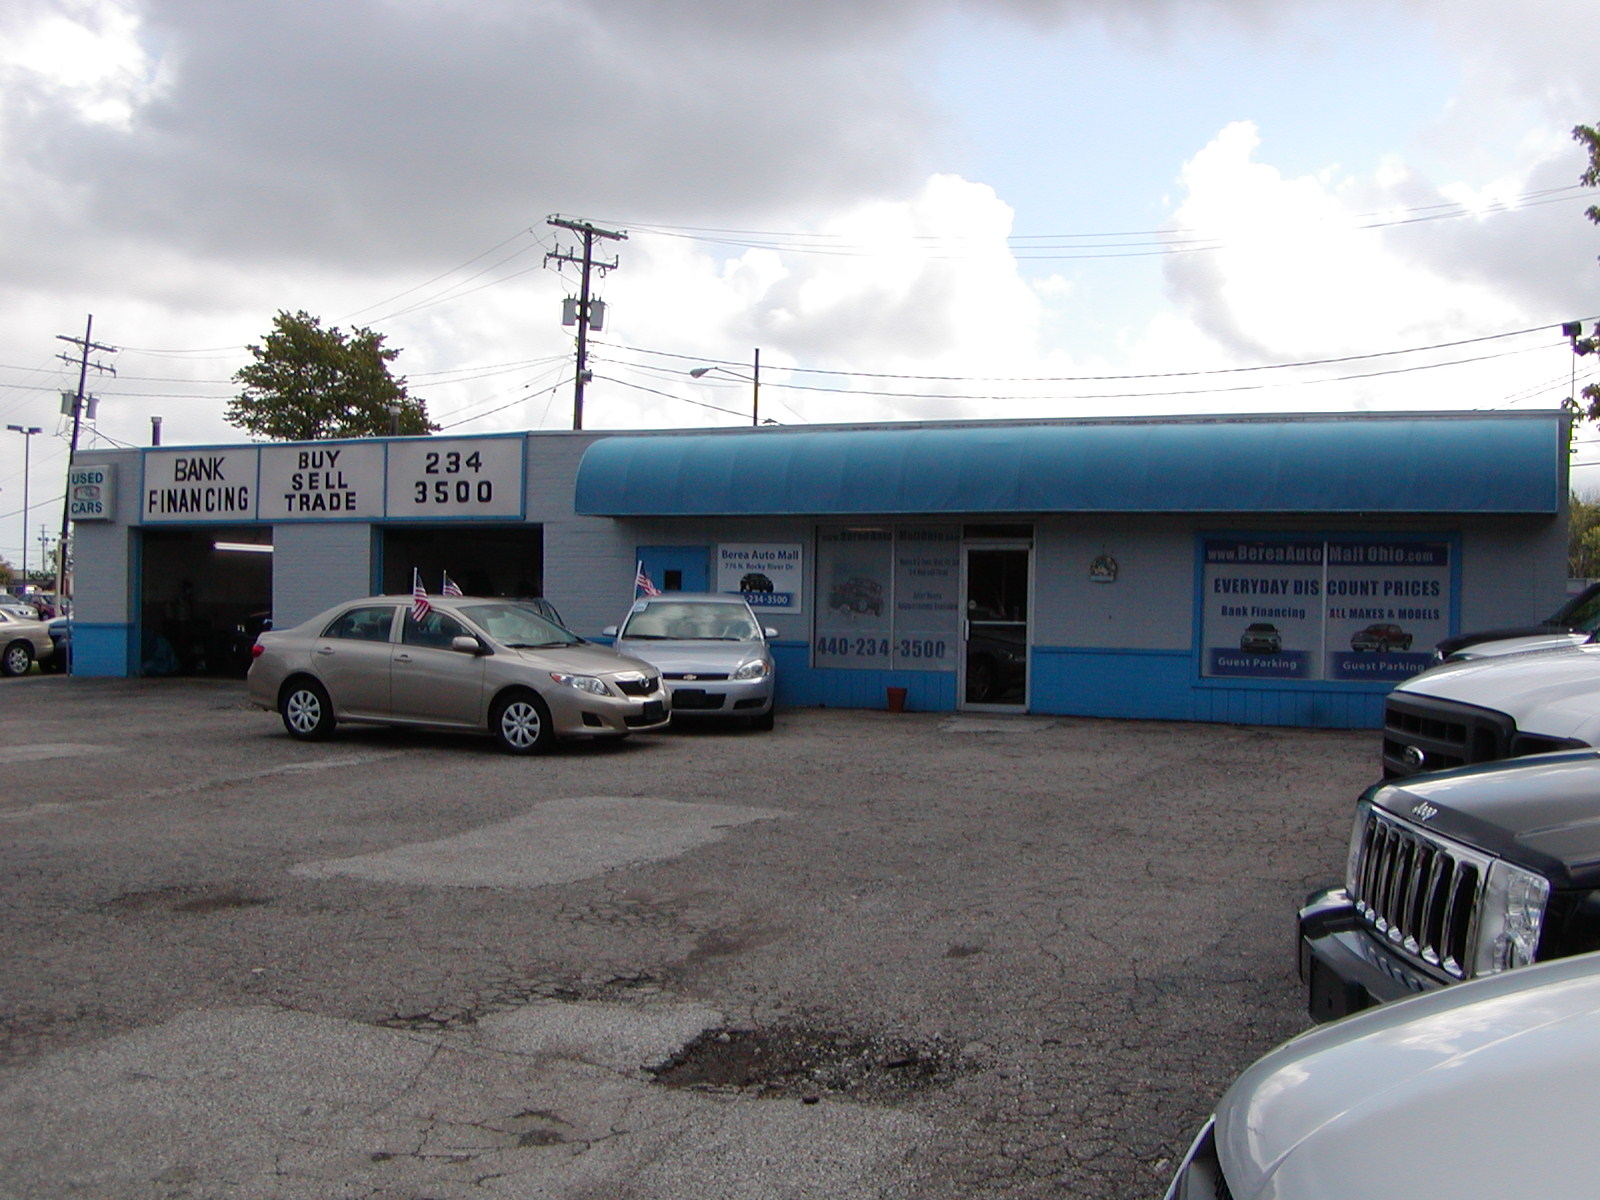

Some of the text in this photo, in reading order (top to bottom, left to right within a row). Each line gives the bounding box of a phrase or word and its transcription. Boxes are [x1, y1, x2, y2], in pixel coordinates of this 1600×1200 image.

[298, 450, 341, 470] BUY
[425, 451, 482, 474] 234
[71, 472, 103, 485] USED
[174, 457, 226, 482] BANK
[291, 471, 348, 491] SELL
[149, 486, 248, 513] FINANCING
[414, 480, 492, 503] 3500
[71, 501, 103, 514] CARS
[284, 491, 356, 512] TRADE
[721, 549, 799, 560] Berea Auto Mall
[1213, 578, 1289, 594] EVERYDAY
[1383, 580, 1440, 596] PRICES
[1221, 605, 1306, 619] Bank Financing
[1329, 607, 1440, 620] ALL MAKES & MODELS
[1218, 657, 1297, 670] Guest Parking
[1342, 661, 1425, 673] Guest Parking
